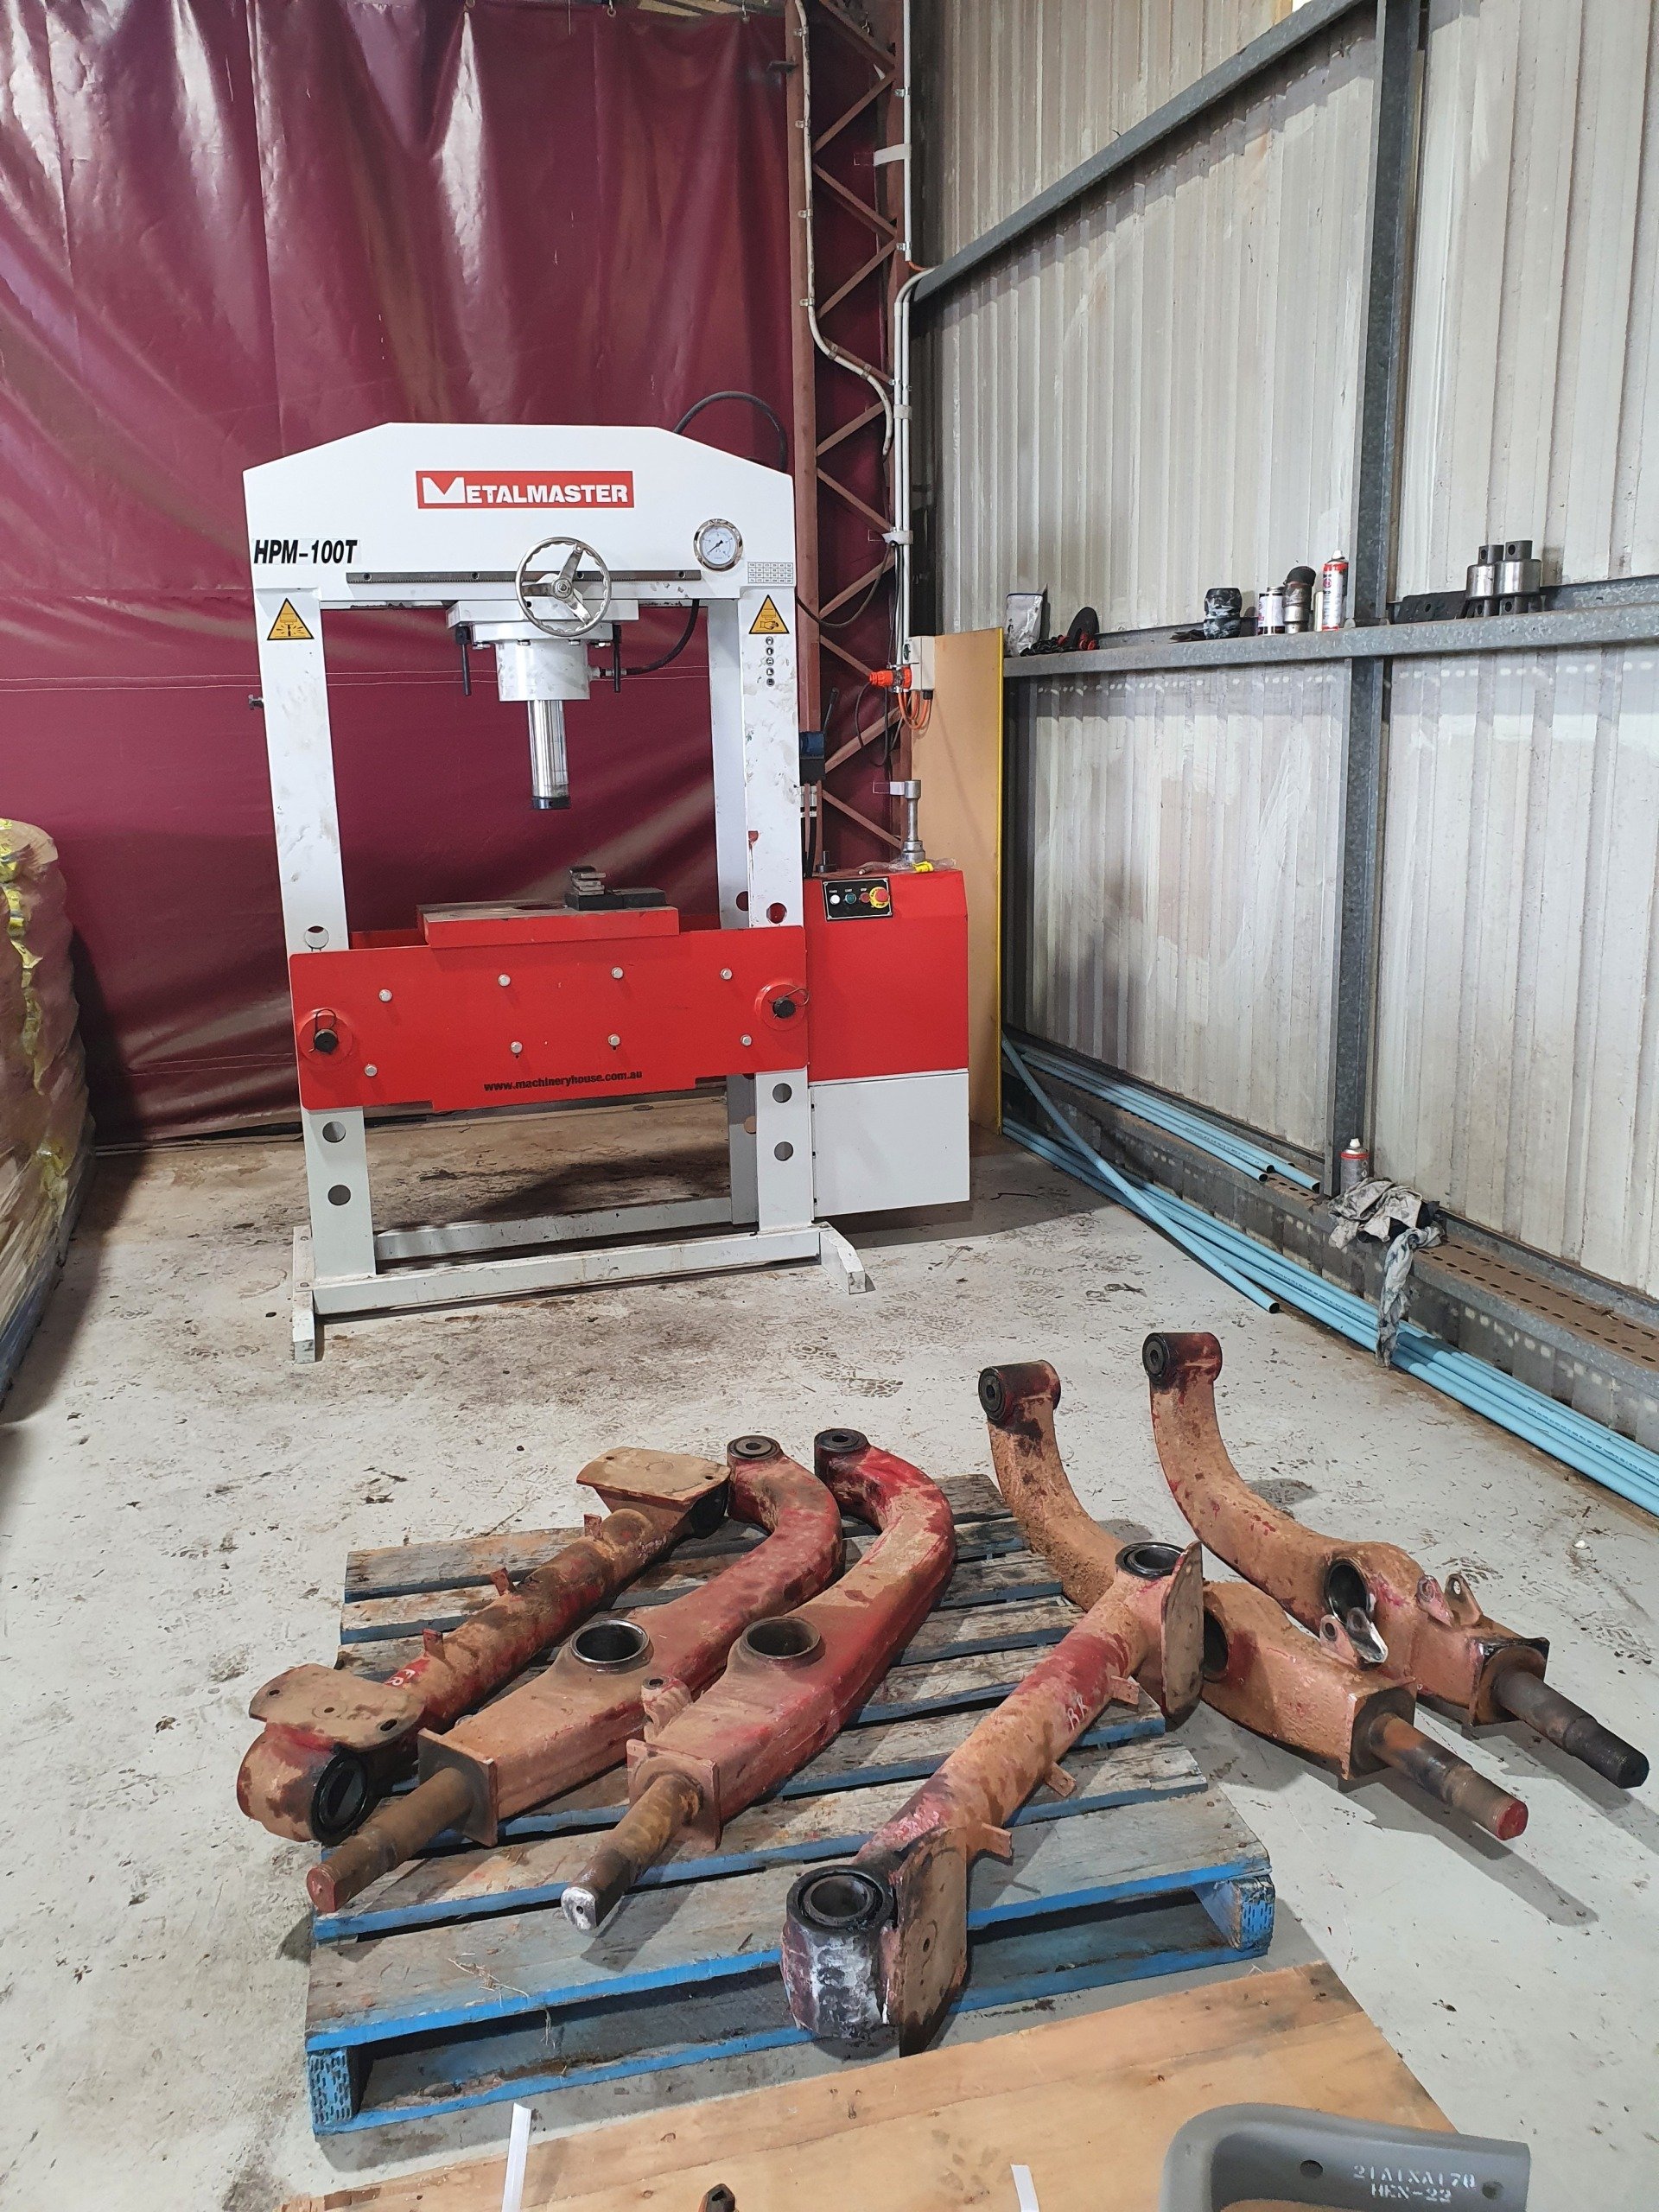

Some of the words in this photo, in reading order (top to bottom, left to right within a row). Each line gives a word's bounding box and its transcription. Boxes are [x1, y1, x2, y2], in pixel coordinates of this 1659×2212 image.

[423, 477, 628, 504] METALMASTER
[253, 540, 357, 564] HPM-100T
[484, 1071, 643, 1091] www.machineryhouse.com.au
